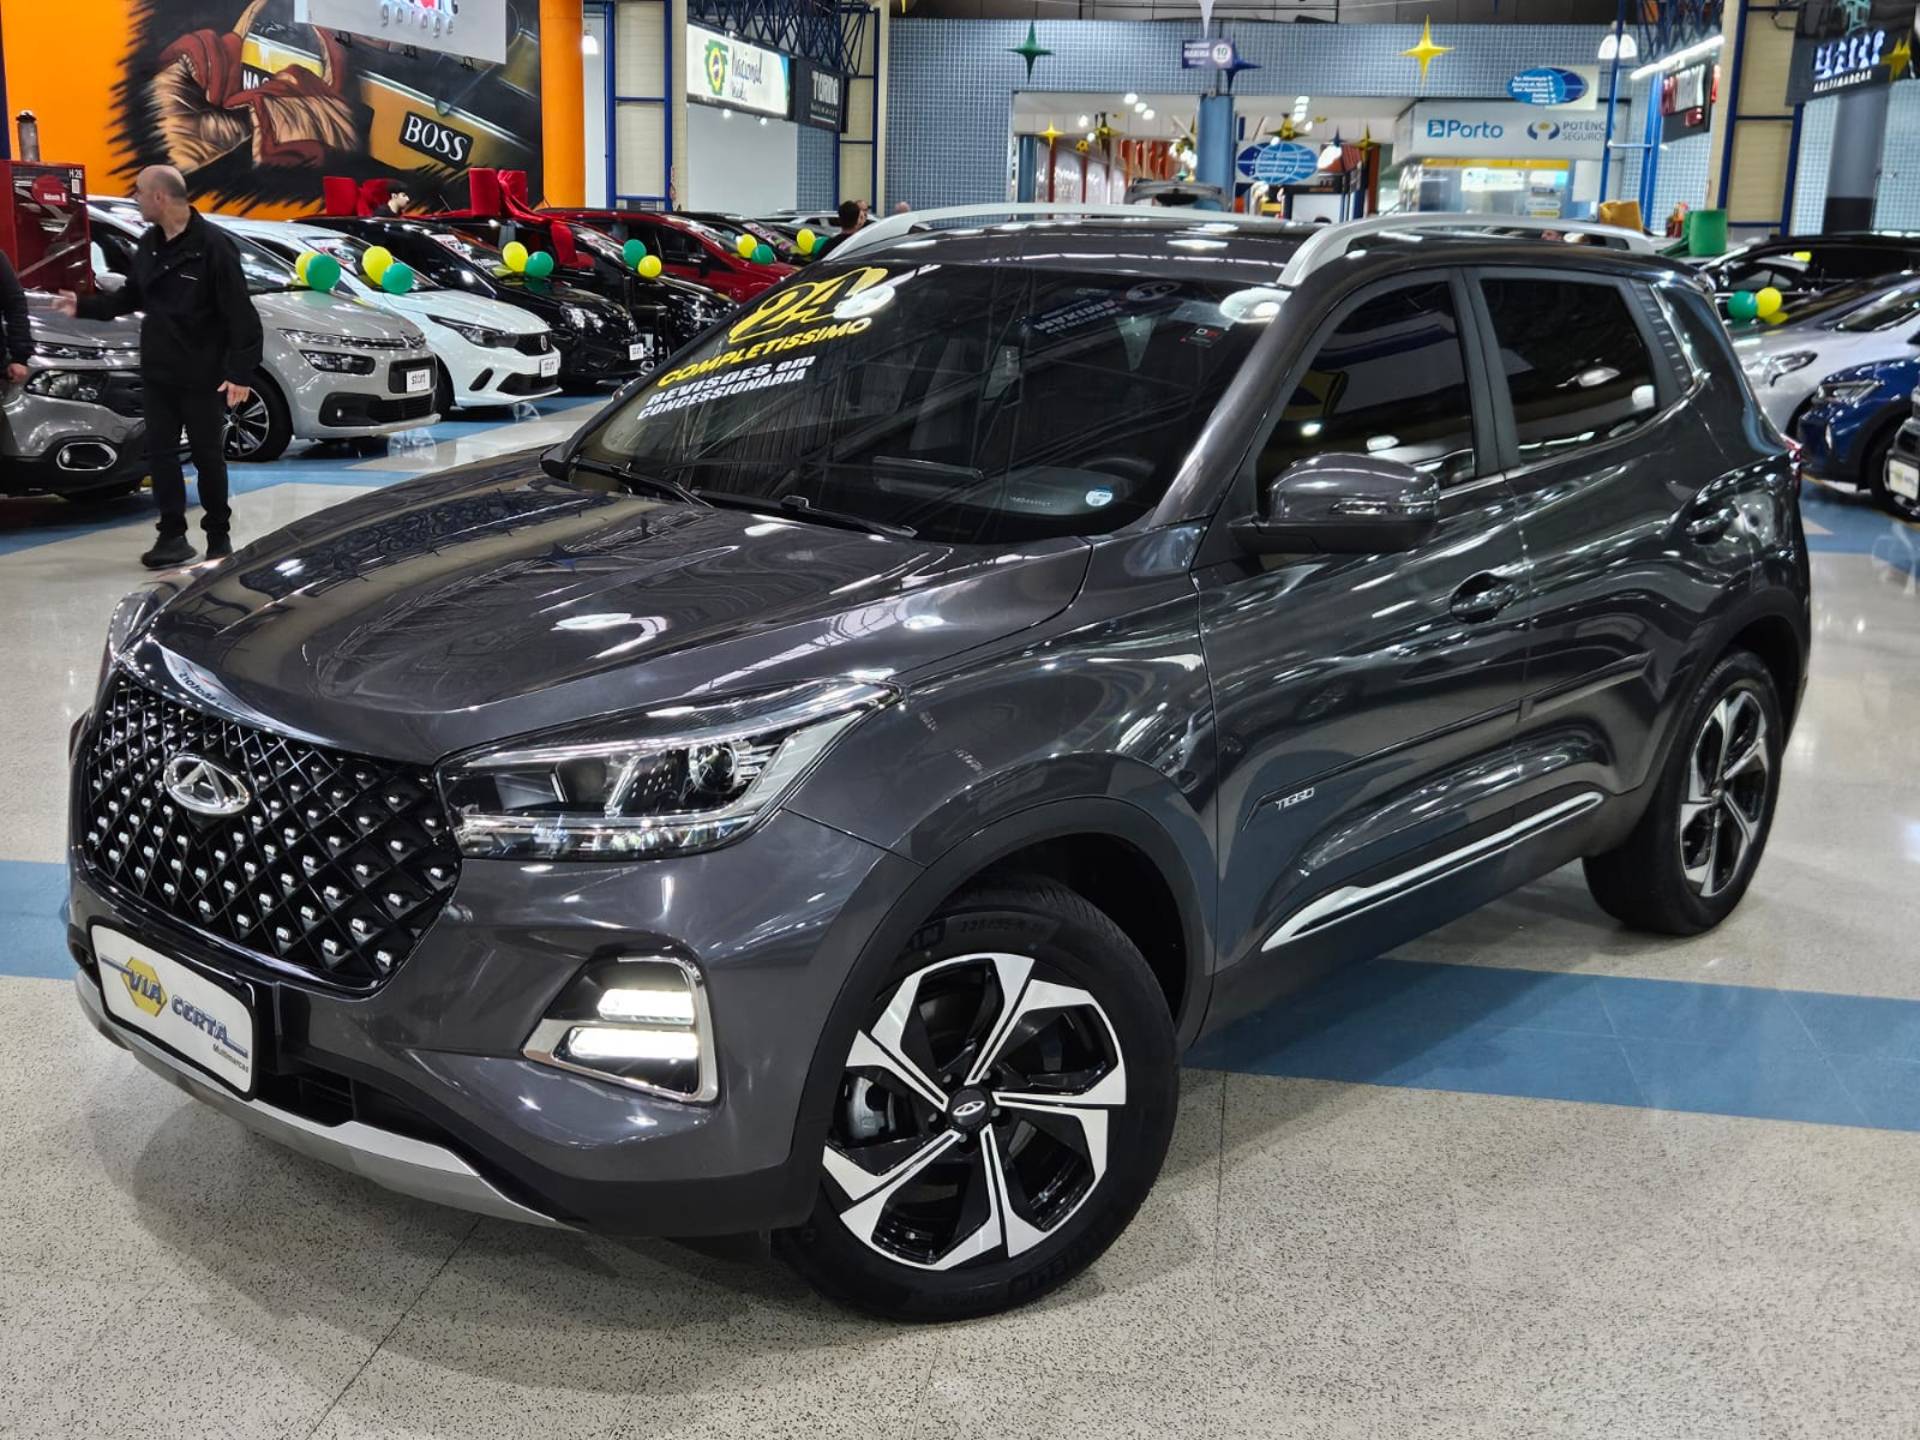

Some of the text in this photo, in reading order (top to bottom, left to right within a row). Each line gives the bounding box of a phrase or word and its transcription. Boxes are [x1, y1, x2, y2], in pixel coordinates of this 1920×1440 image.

[382, 4, 454, 38] garage
[404, 115, 468, 161] BOSS
[1447, 119, 1504, 139] Porto
[1562, 119, 1616, 132] POTÊNC
[728, 267, 889, 343] 24
[657, 317, 873, 387] COMPLETISSIMO
[1275, 787, 1315, 810] TIGGO
[129, 968, 162, 1005] VIA
[171, 994, 229, 1045] CERTA
